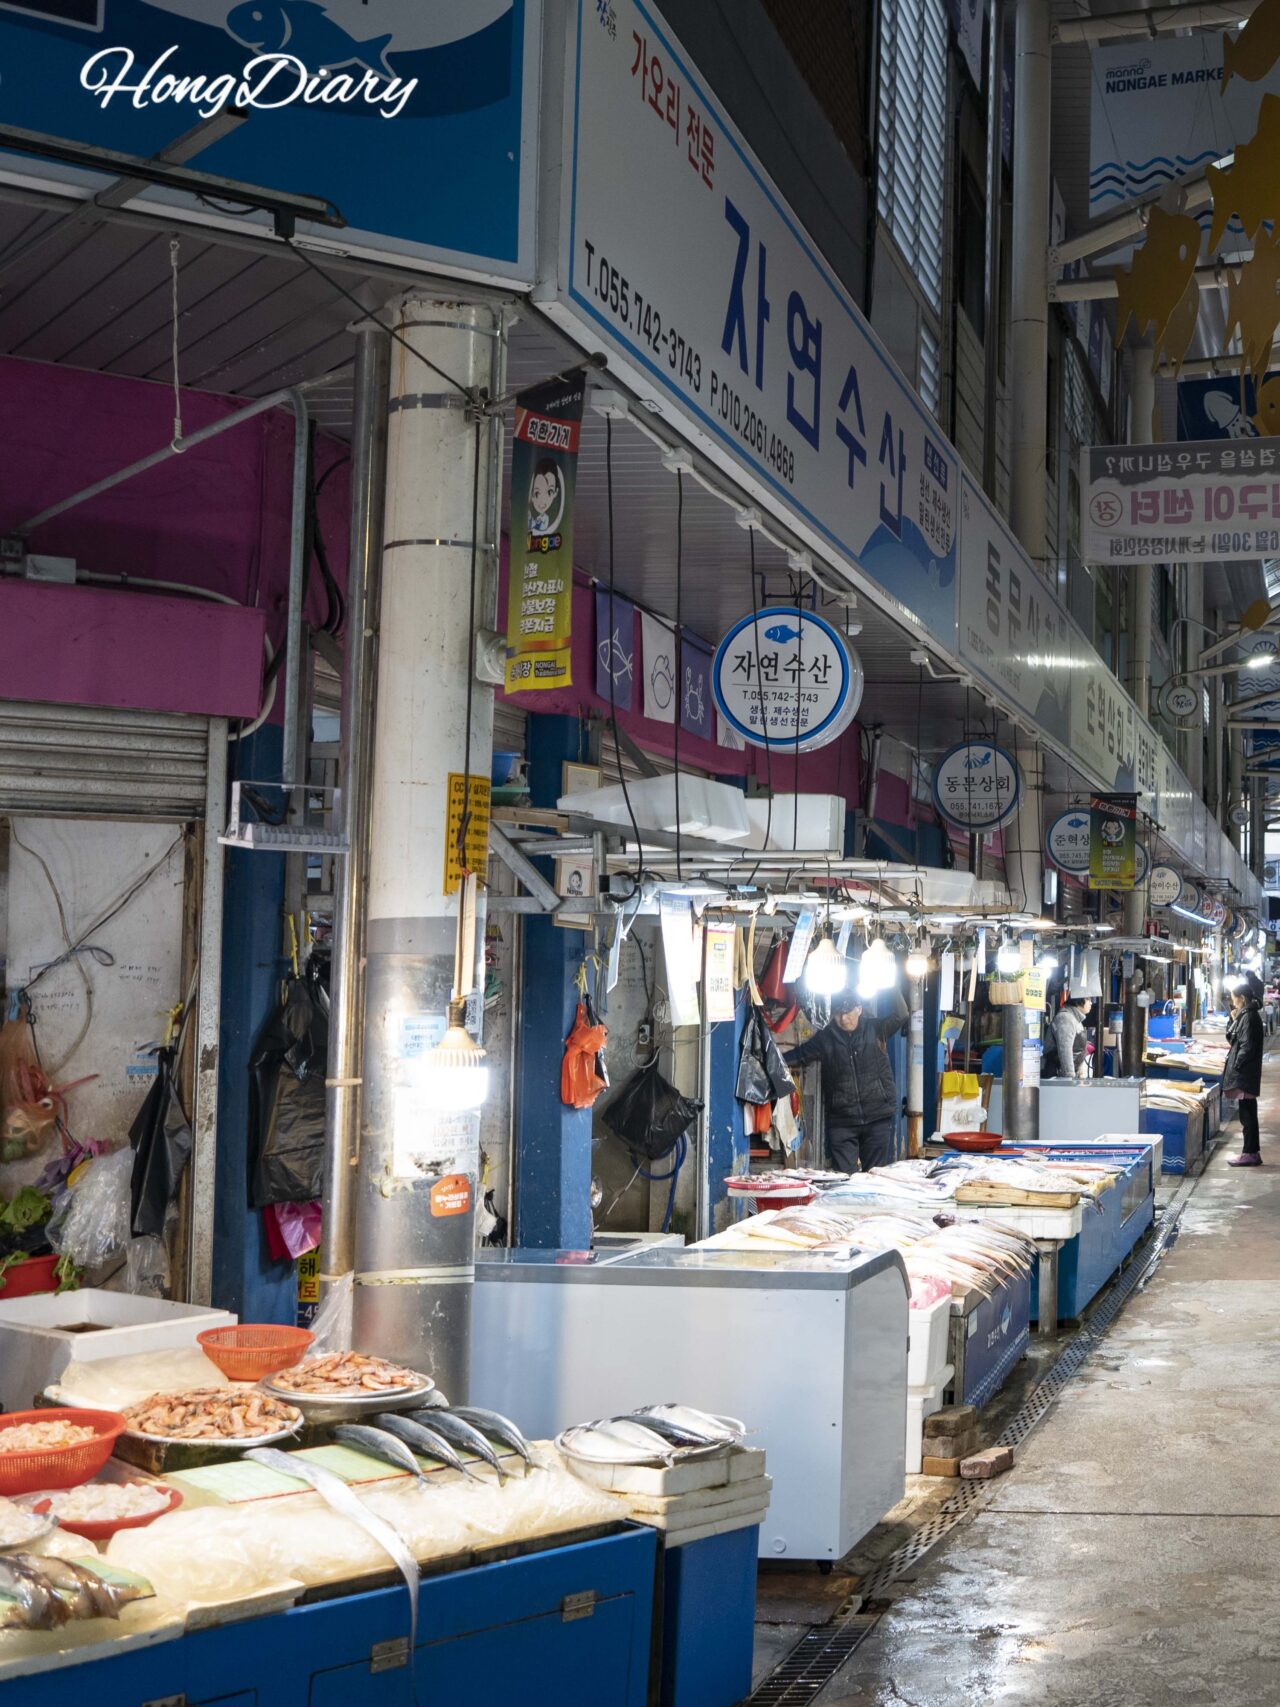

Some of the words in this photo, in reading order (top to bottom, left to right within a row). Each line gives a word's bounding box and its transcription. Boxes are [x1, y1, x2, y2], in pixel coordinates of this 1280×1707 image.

[1106, 68, 1143, 79] manna
[1106, 74, 1167, 93] NONGAE
[1172, 67, 1233, 85] MARKE
[631, 29, 680, 147] 가오리
[687, 104, 715, 191] 전문
[584, 239, 702, 393] T.055.742-3743
[722, 196, 906, 543] 자연수산
[528, 418, 571, 450] 착한가게
[710, 370, 795, 485] P.010.2061.4868
[732, 650, 831, 684] 자연수산
[743, 691, 819, 703] T.055.742-3743
[454, 782, 471, 794] CCV
[945, 776, 1010, 792] 동문상회
